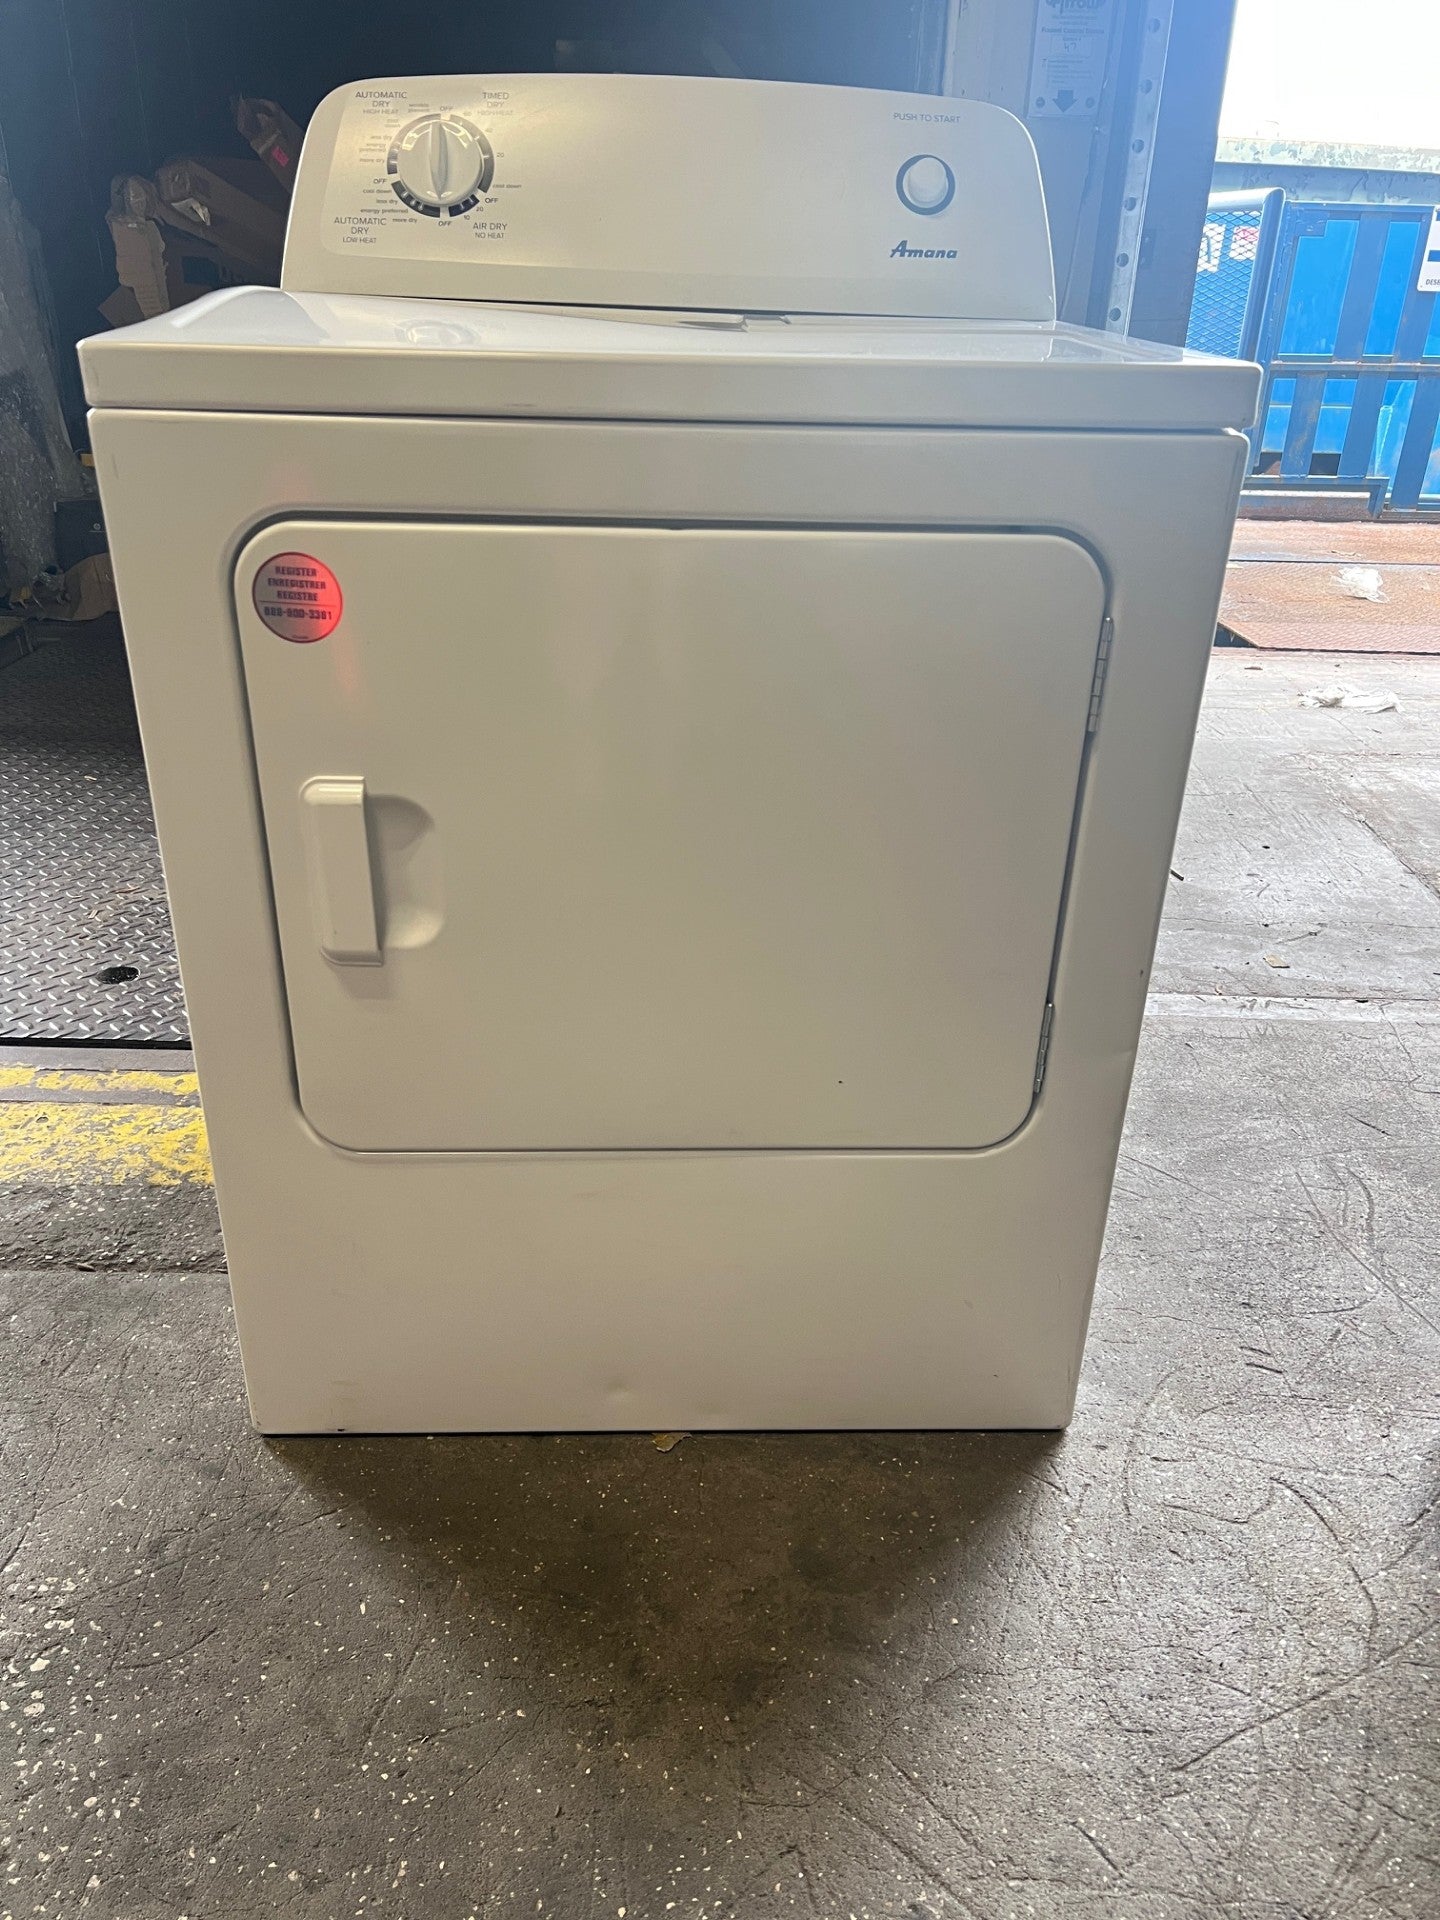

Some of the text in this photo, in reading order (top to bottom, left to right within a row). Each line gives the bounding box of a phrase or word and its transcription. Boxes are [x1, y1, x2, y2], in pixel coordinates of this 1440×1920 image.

[355, 91, 408, 99] AUTOMATIC
[482, 92, 509, 100] TIMED
[372, 100, 390, 108] DRY
[893, 113, 917, 121] PUSH
[934, 115, 961, 123] START
[334, 217, 387, 226] AUTOMATIC
[351, 227, 369, 235] DRY
[489, 223, 508, 231] DRY
[890, 239, 958, 259] Amana
[275, 566, 317, 577] REGISTER
[267, 577, 326, 590] ENREGISTRER
[277, 590, 319, 601] REGISTRE
